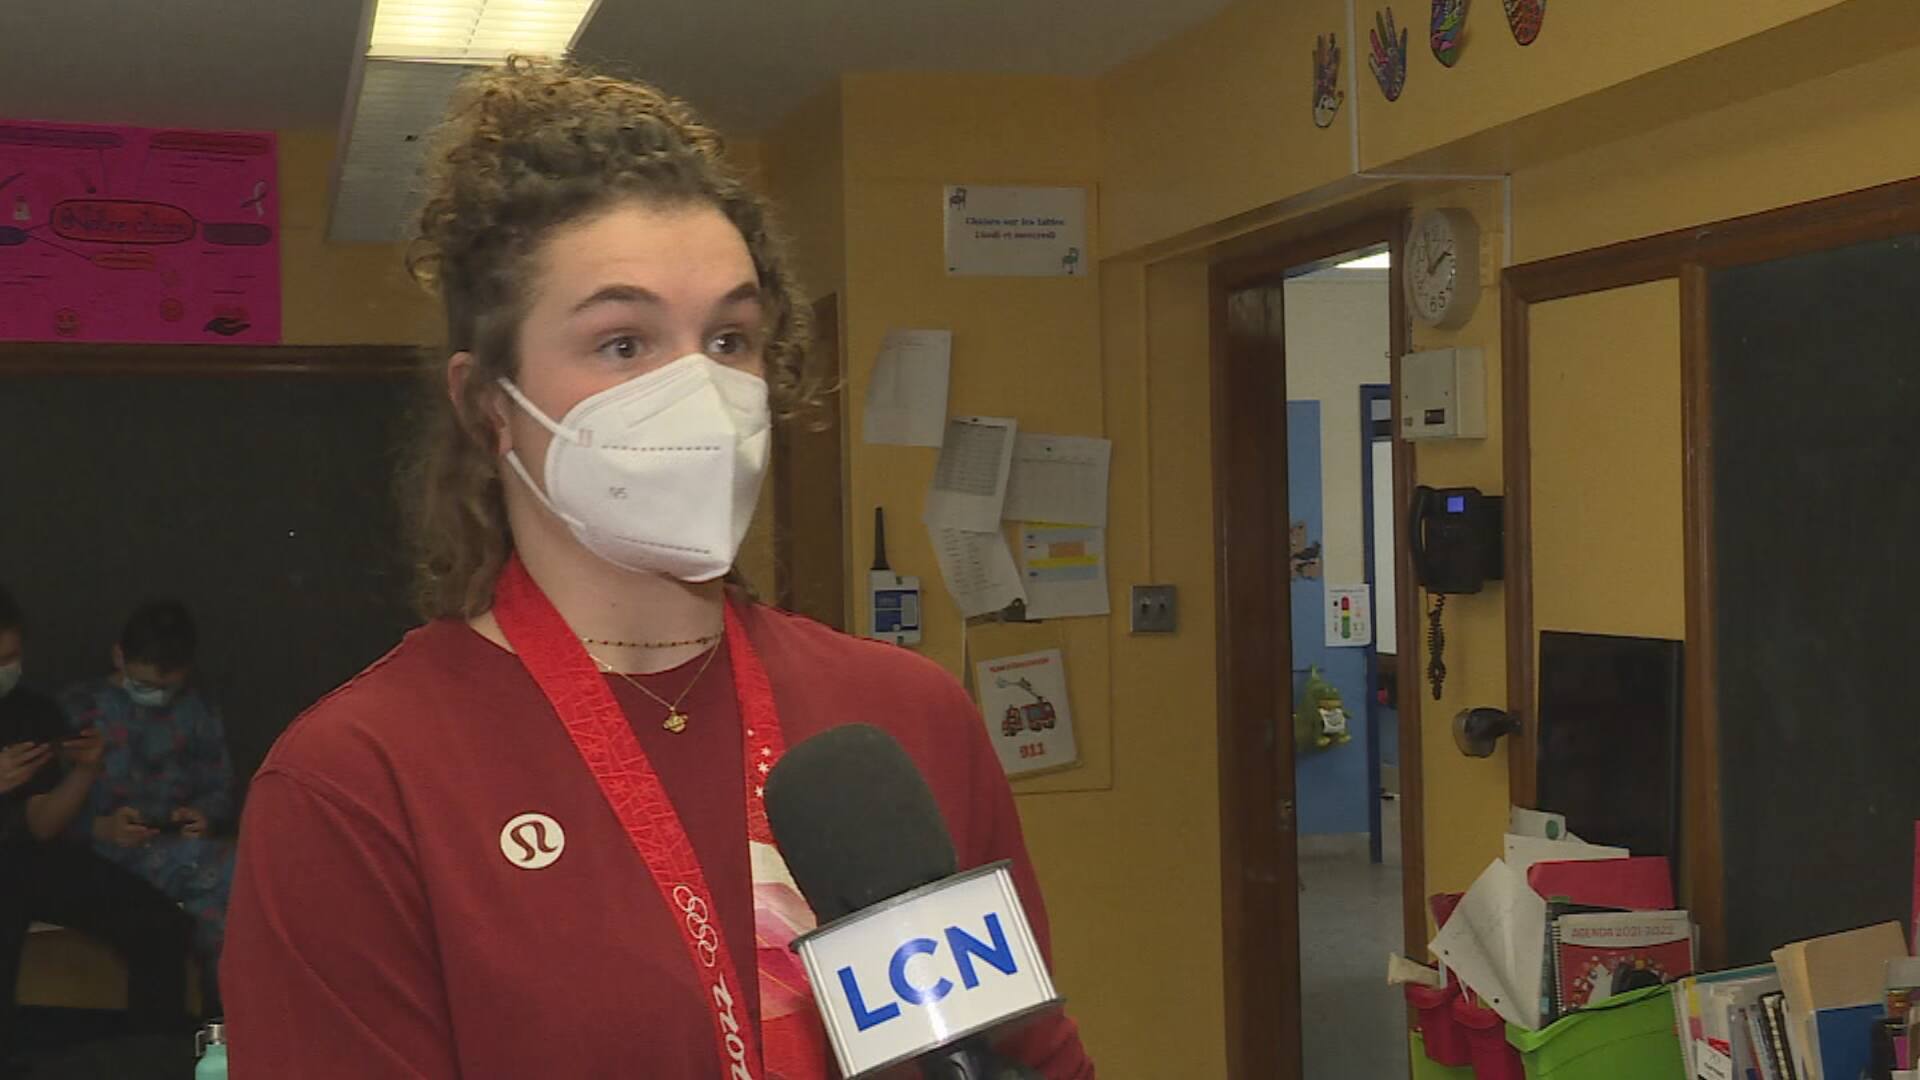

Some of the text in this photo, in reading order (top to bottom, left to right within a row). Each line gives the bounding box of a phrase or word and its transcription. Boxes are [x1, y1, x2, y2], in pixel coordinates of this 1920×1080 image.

[1019, 742, 1045, 759] 911
[1571, 927, 1614, 937] AGENDA
[836, 911, 1019, 1032] LCN
